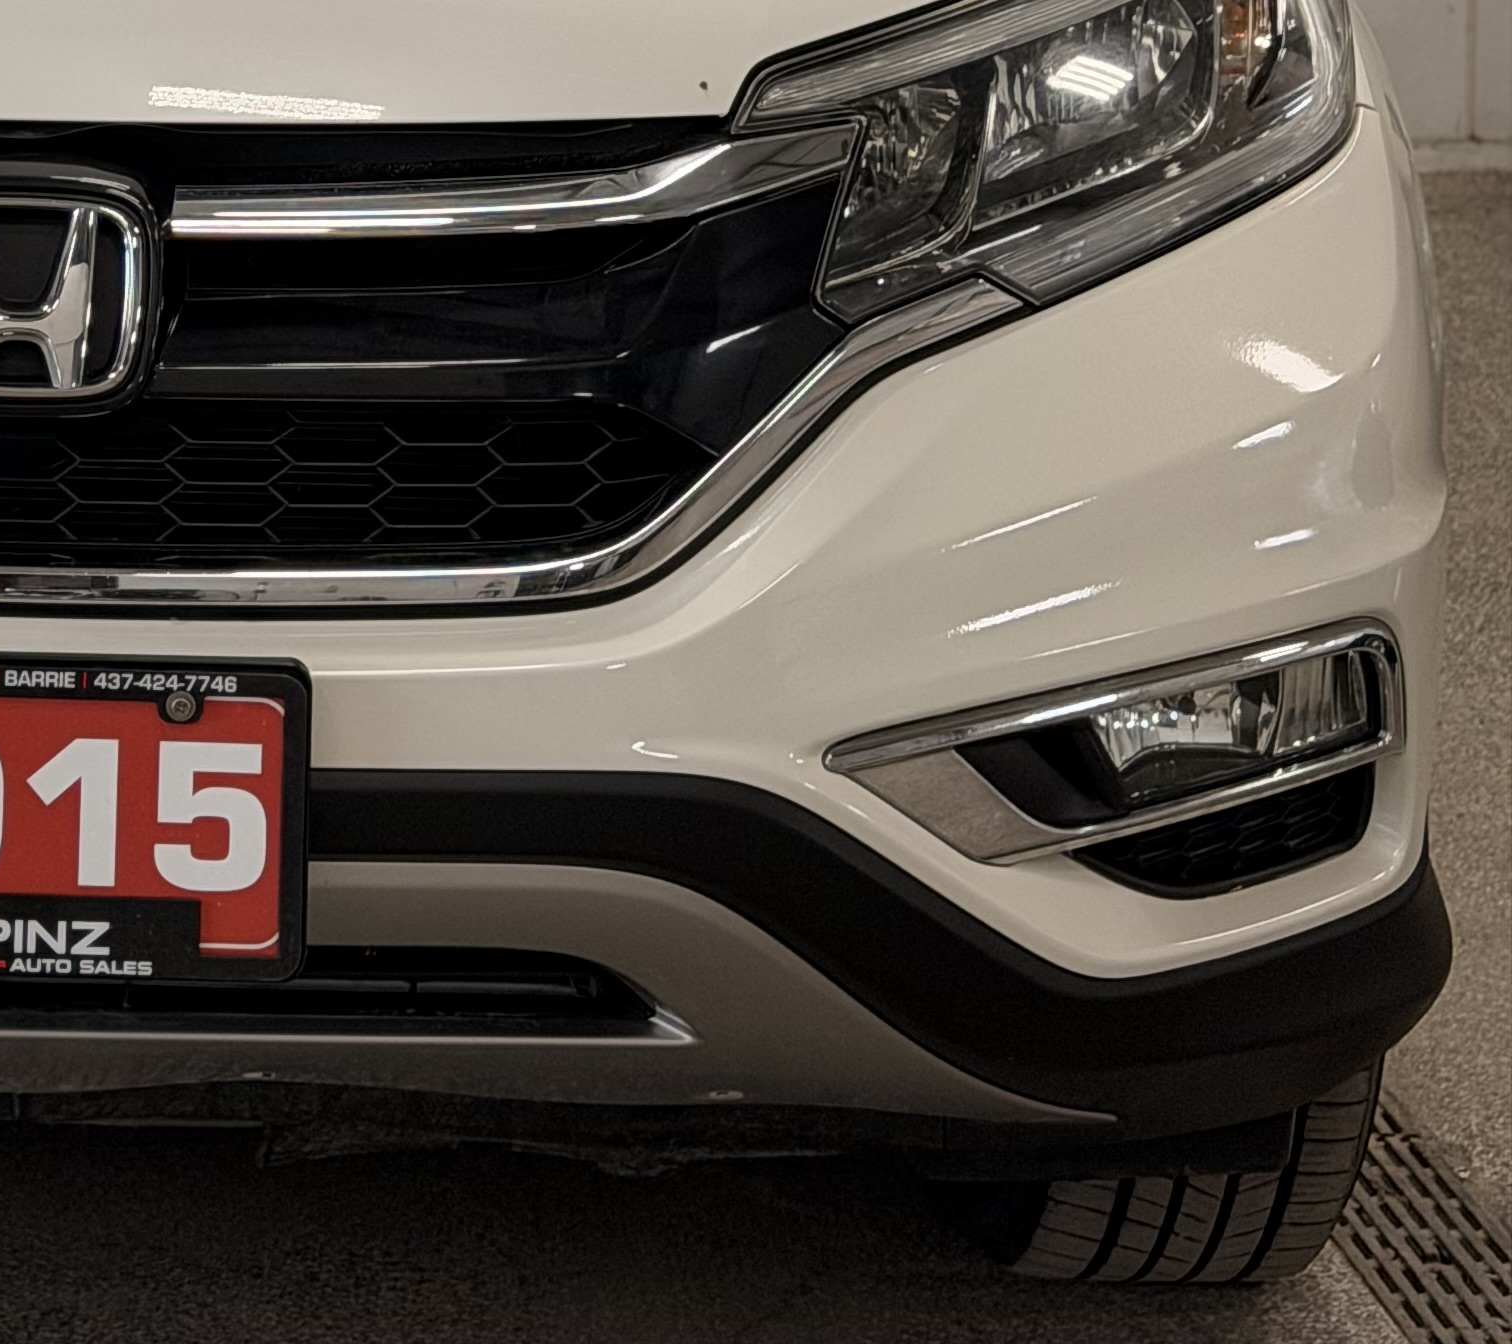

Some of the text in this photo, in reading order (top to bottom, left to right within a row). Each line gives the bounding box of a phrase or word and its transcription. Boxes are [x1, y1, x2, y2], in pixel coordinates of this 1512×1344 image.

[4, 670, 76, 688] BARRIE
[93, 673, 237, 692] 437-424-7746
[9, 958, 153, 976] AUTO SALES
